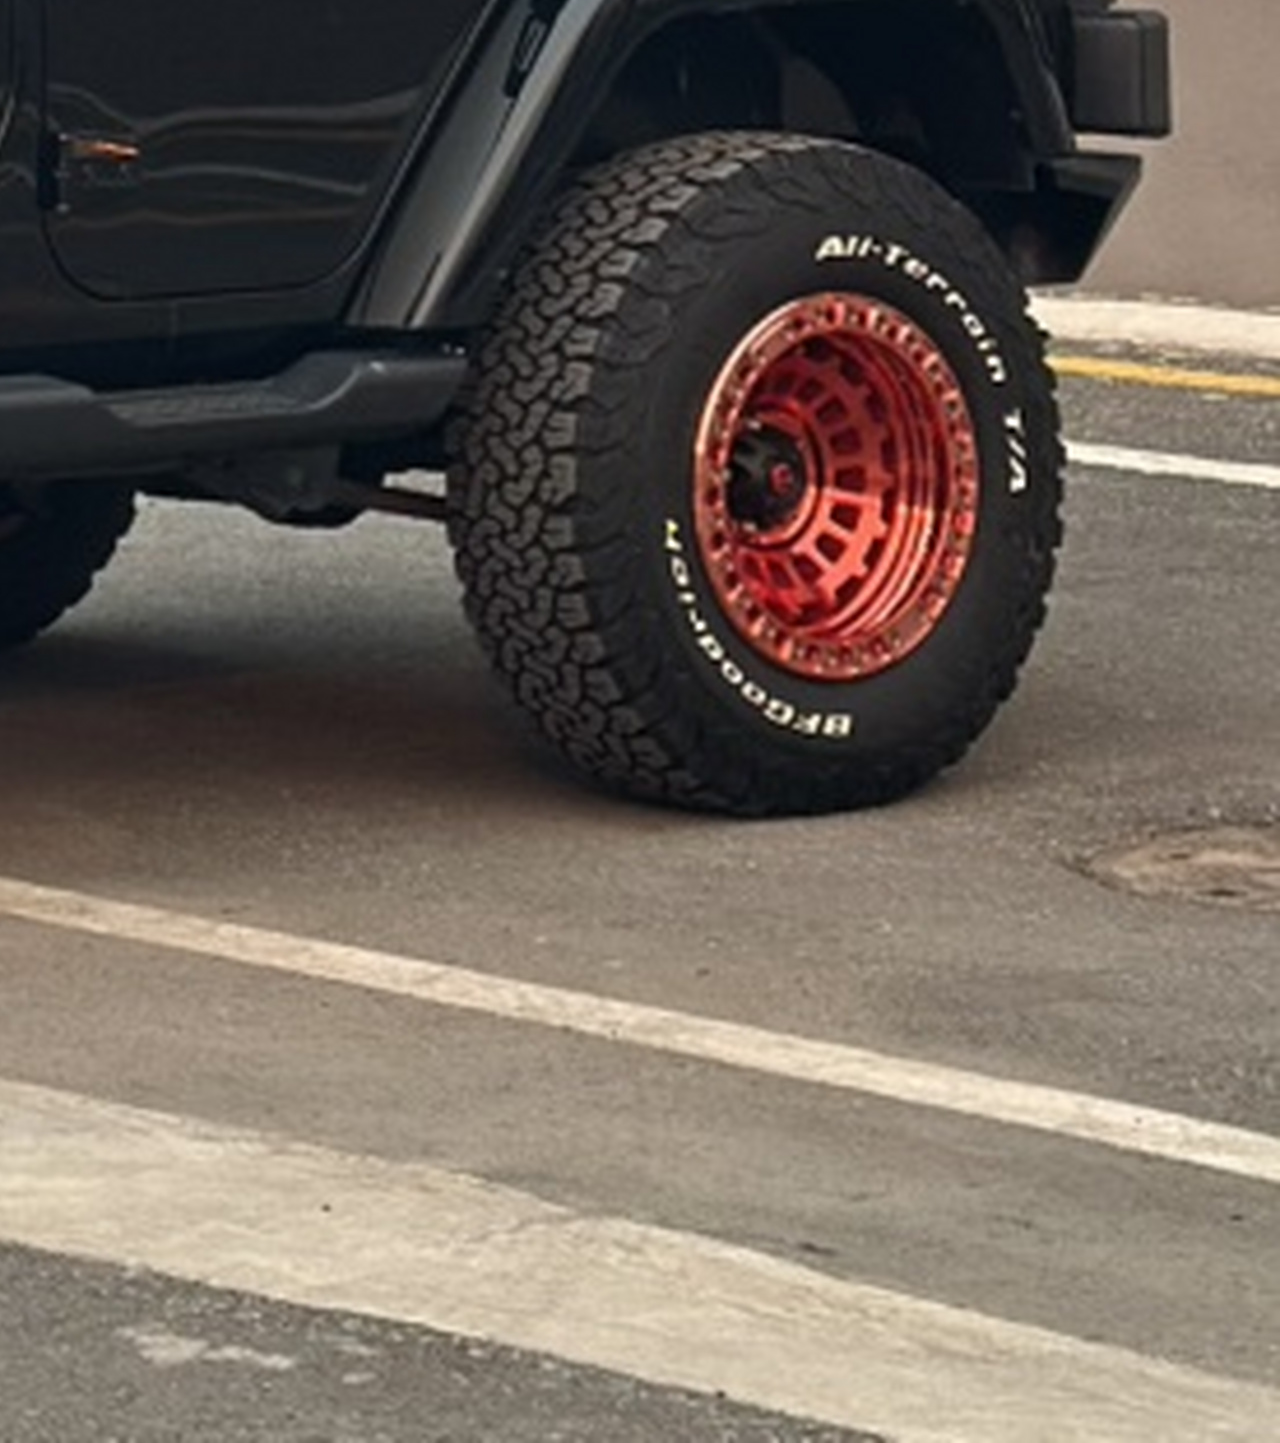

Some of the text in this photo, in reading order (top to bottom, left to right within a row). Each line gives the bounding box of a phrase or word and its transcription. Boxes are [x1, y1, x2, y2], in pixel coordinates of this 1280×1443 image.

[814, 234, 1028, 494] All-Terrain T/A
[664, 518, 854, 738] BFGoodrich
